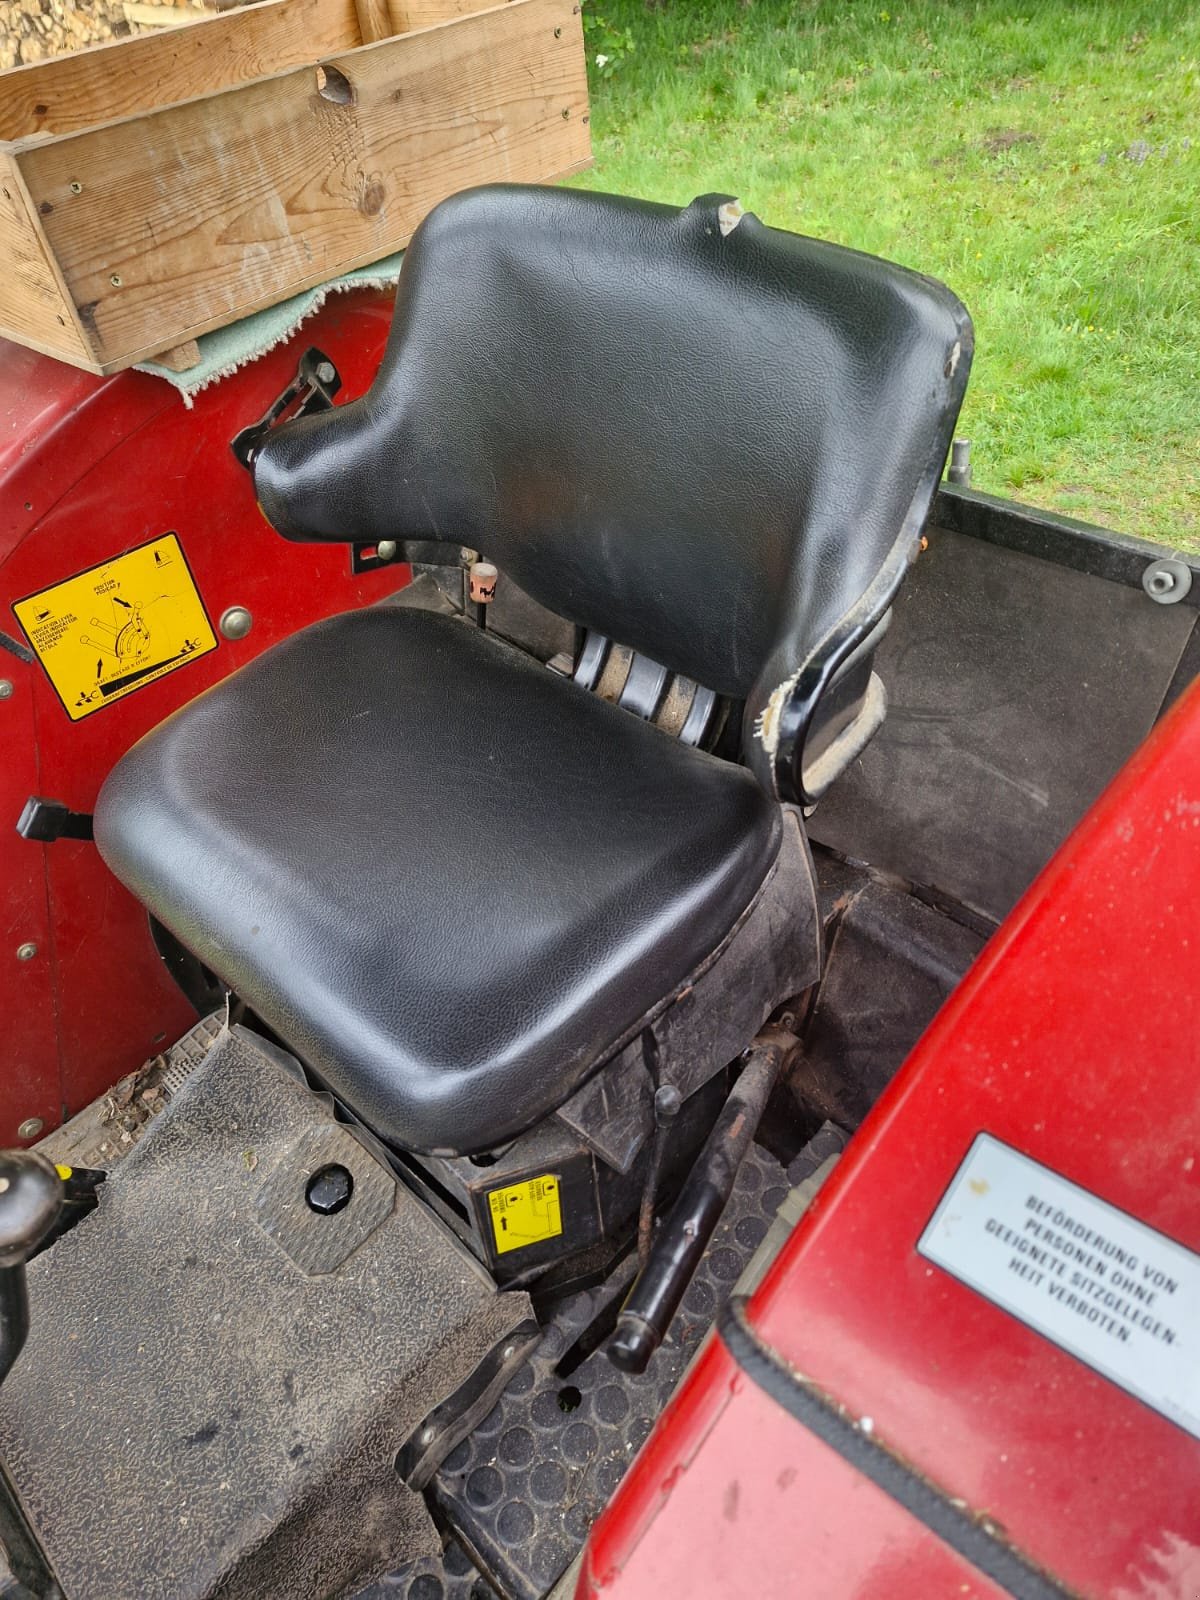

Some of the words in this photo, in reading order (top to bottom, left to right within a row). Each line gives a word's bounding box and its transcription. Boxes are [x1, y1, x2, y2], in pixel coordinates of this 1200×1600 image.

[984, 1217, 1067, 1277] GEEIGNETE
[1008, 1257, 1045, 1288] HEIT
[1024, 1195, 1139, 1271] BEFÖRDERUNG
[1141, 1264, 1179, 1295] VON
[1024, 1218, 1108, 1276] PERSONEN
[1110, 1270, 1159, 1307] OHNE
